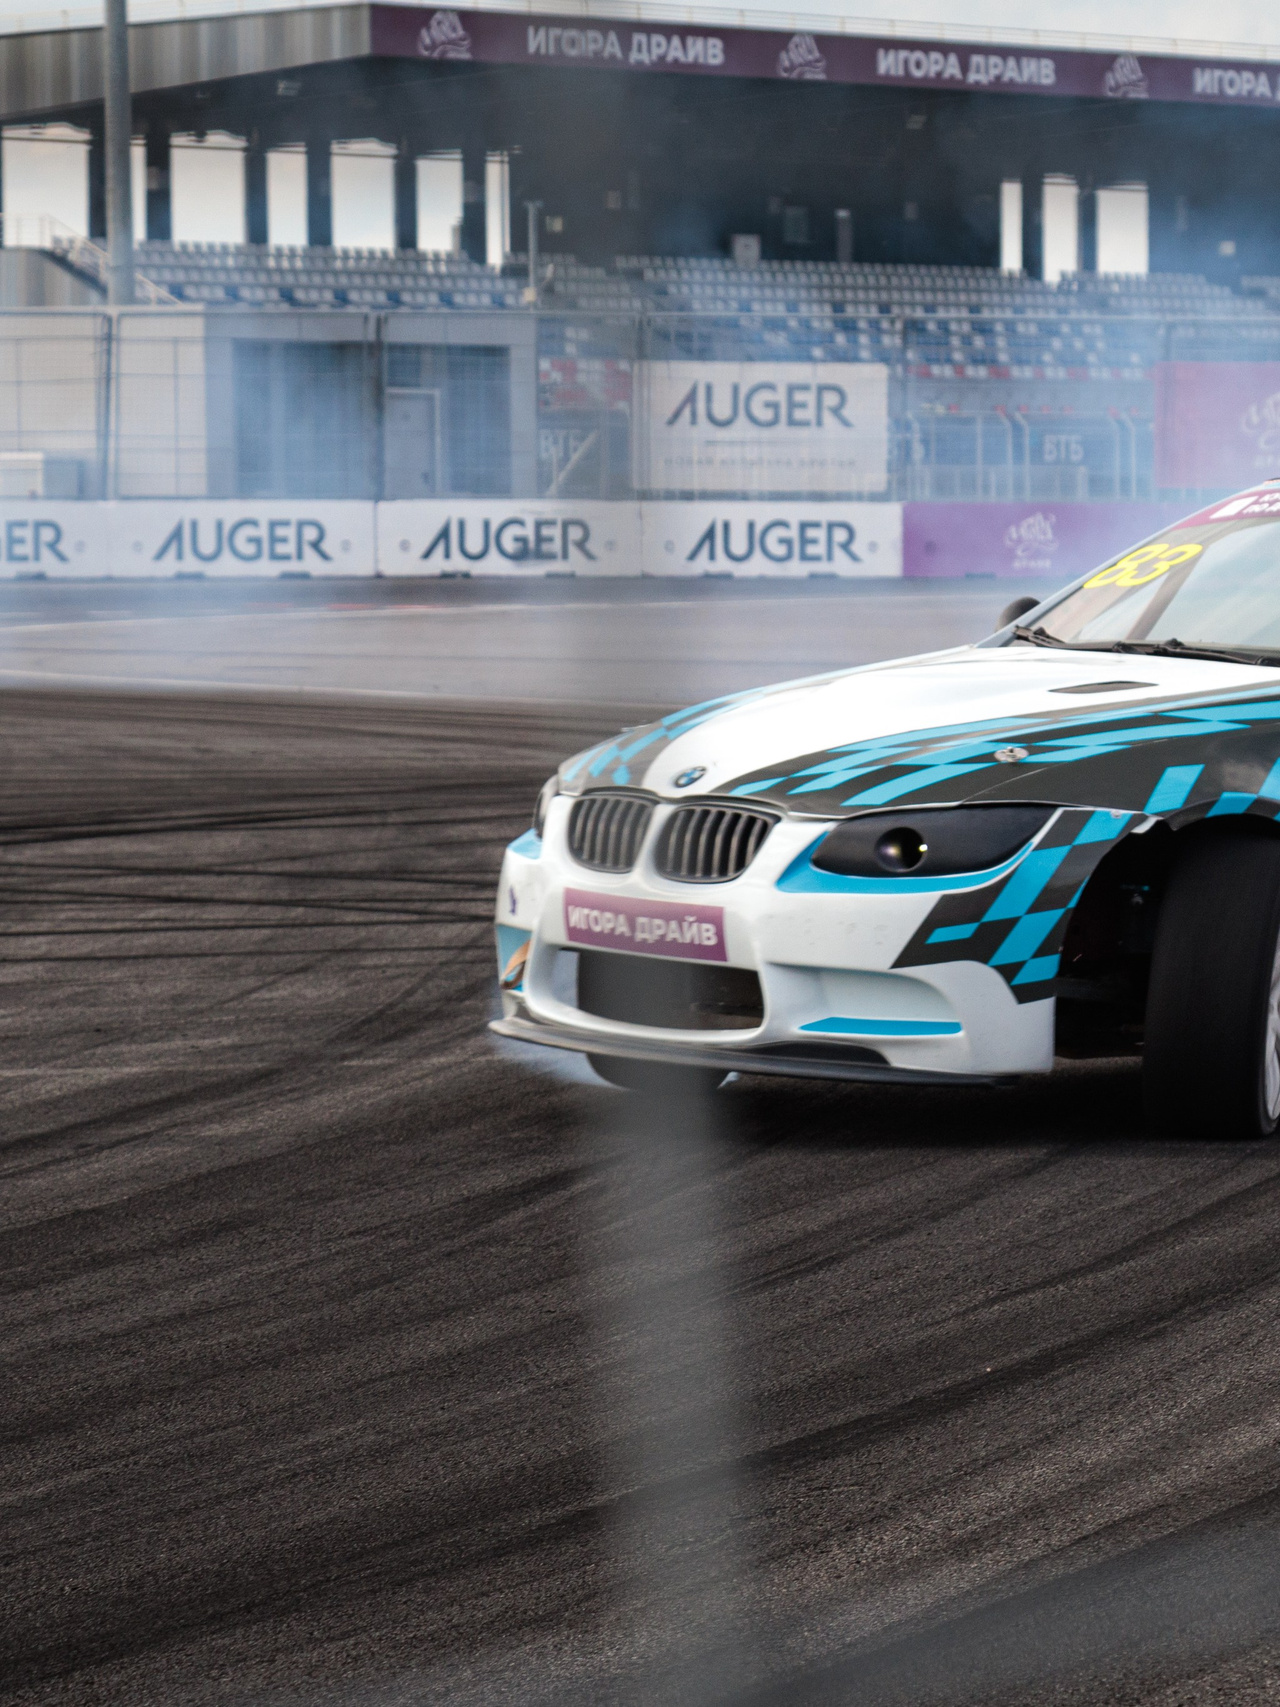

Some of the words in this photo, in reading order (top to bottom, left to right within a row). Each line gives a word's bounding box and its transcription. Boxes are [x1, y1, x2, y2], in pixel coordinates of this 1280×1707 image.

[527, 25, 623, 60] ИГОРА
[876, 48, 963, 80] ИГОРА
[1193, 67, 1273, 98] ИГОРА
[666, 380, 855, 428] AUGER
[0, 520, 69, 563] ER
[152, 517, 333, 563] AUGER
[420, 516, 598, 561] AUGER
[686, 517, 863, 563] AUGER
[1083, 543, 1203, 589] 83
[567, 905, 632, 937] ИГОРА
[634, 915, 718, 946] ДРАЙВ
